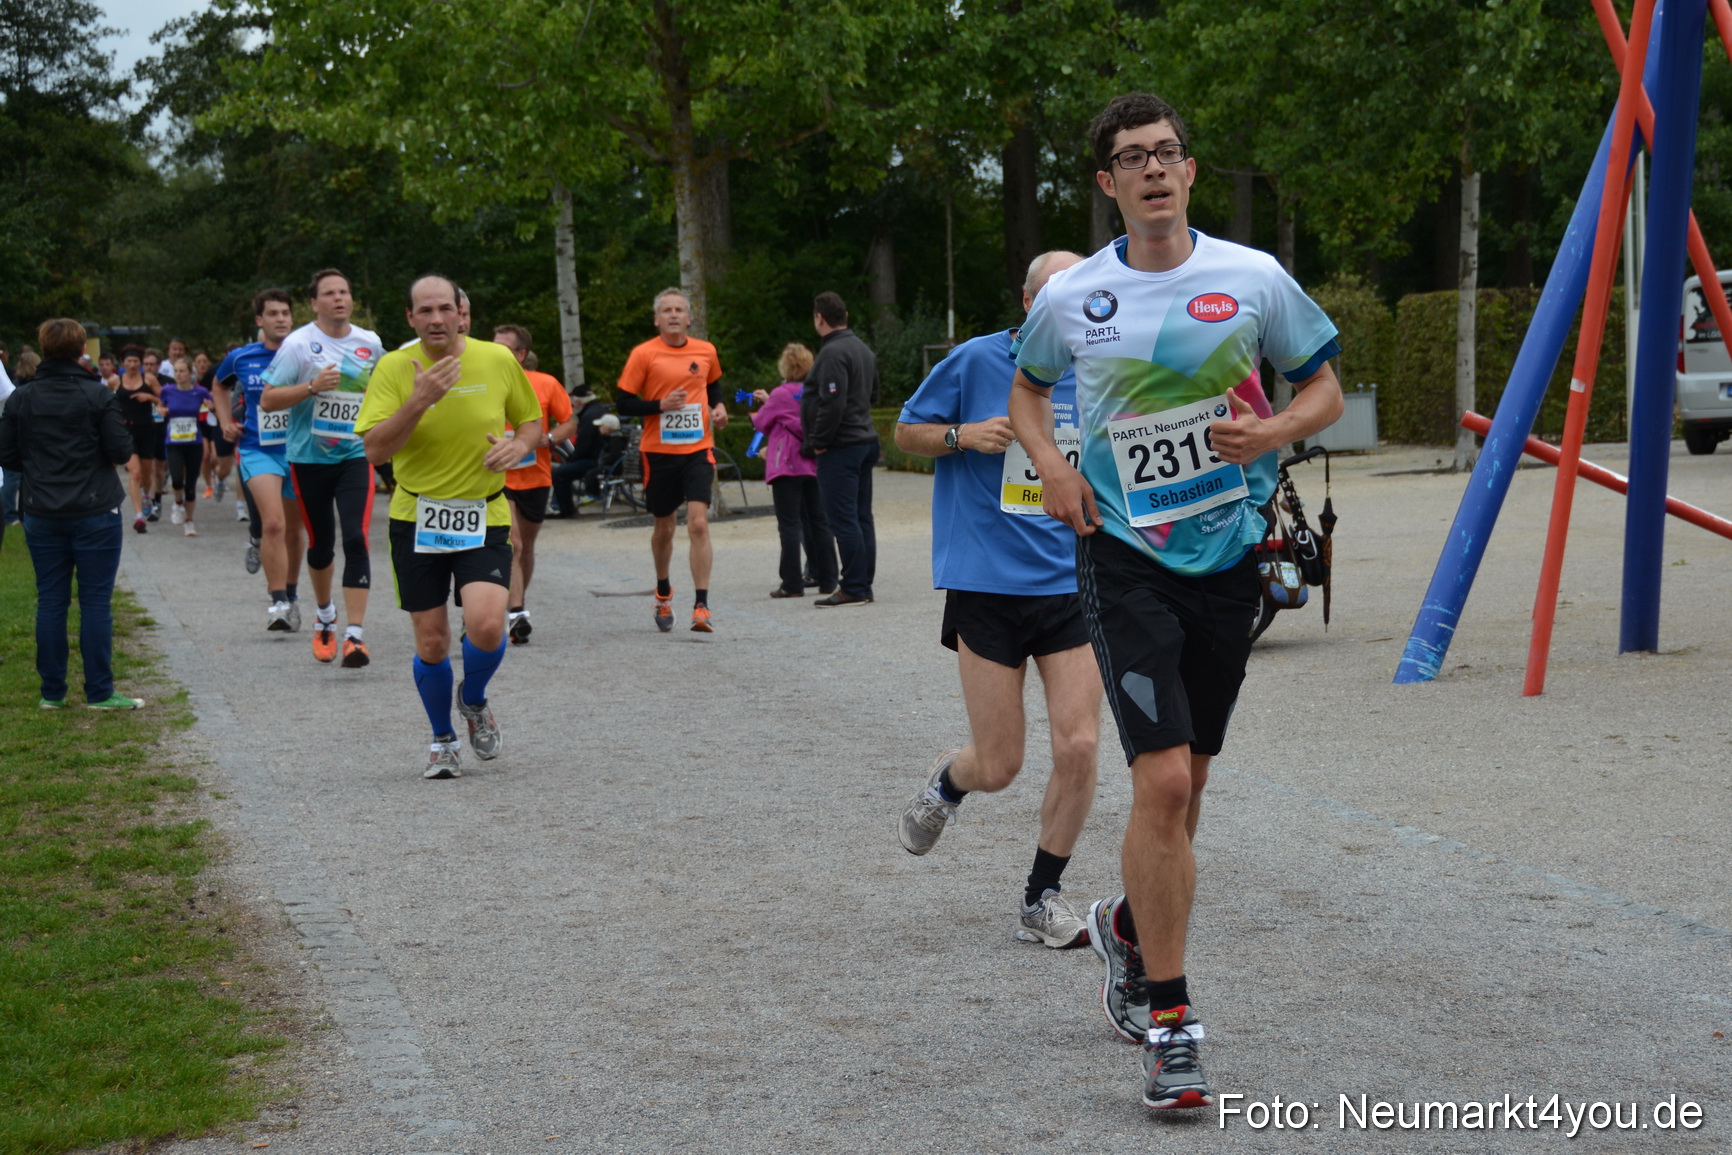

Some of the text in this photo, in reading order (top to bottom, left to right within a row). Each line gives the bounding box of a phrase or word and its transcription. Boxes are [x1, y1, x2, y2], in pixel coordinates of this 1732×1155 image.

[1086, 291, 1115, 303] BMW
[1194, 301, 1233, 314] Hervis
[1085, 326, 1120, 339] PARTL
[1086, 335, 1121, 346] Neumarkt
[319, 402, 359, 421] 2082
[263, 414, 288, 429] 238
[665, 414, 699, 429] 2255
[1112, 410, 1211, 442] PARTL Neumarkt
[1022, 489, 1043, 503] Rei
[1148, 477, 1224, 509] Sebastian
[424, 507, 480, 533] 2089
[434, 534, 466, 547] Markus
